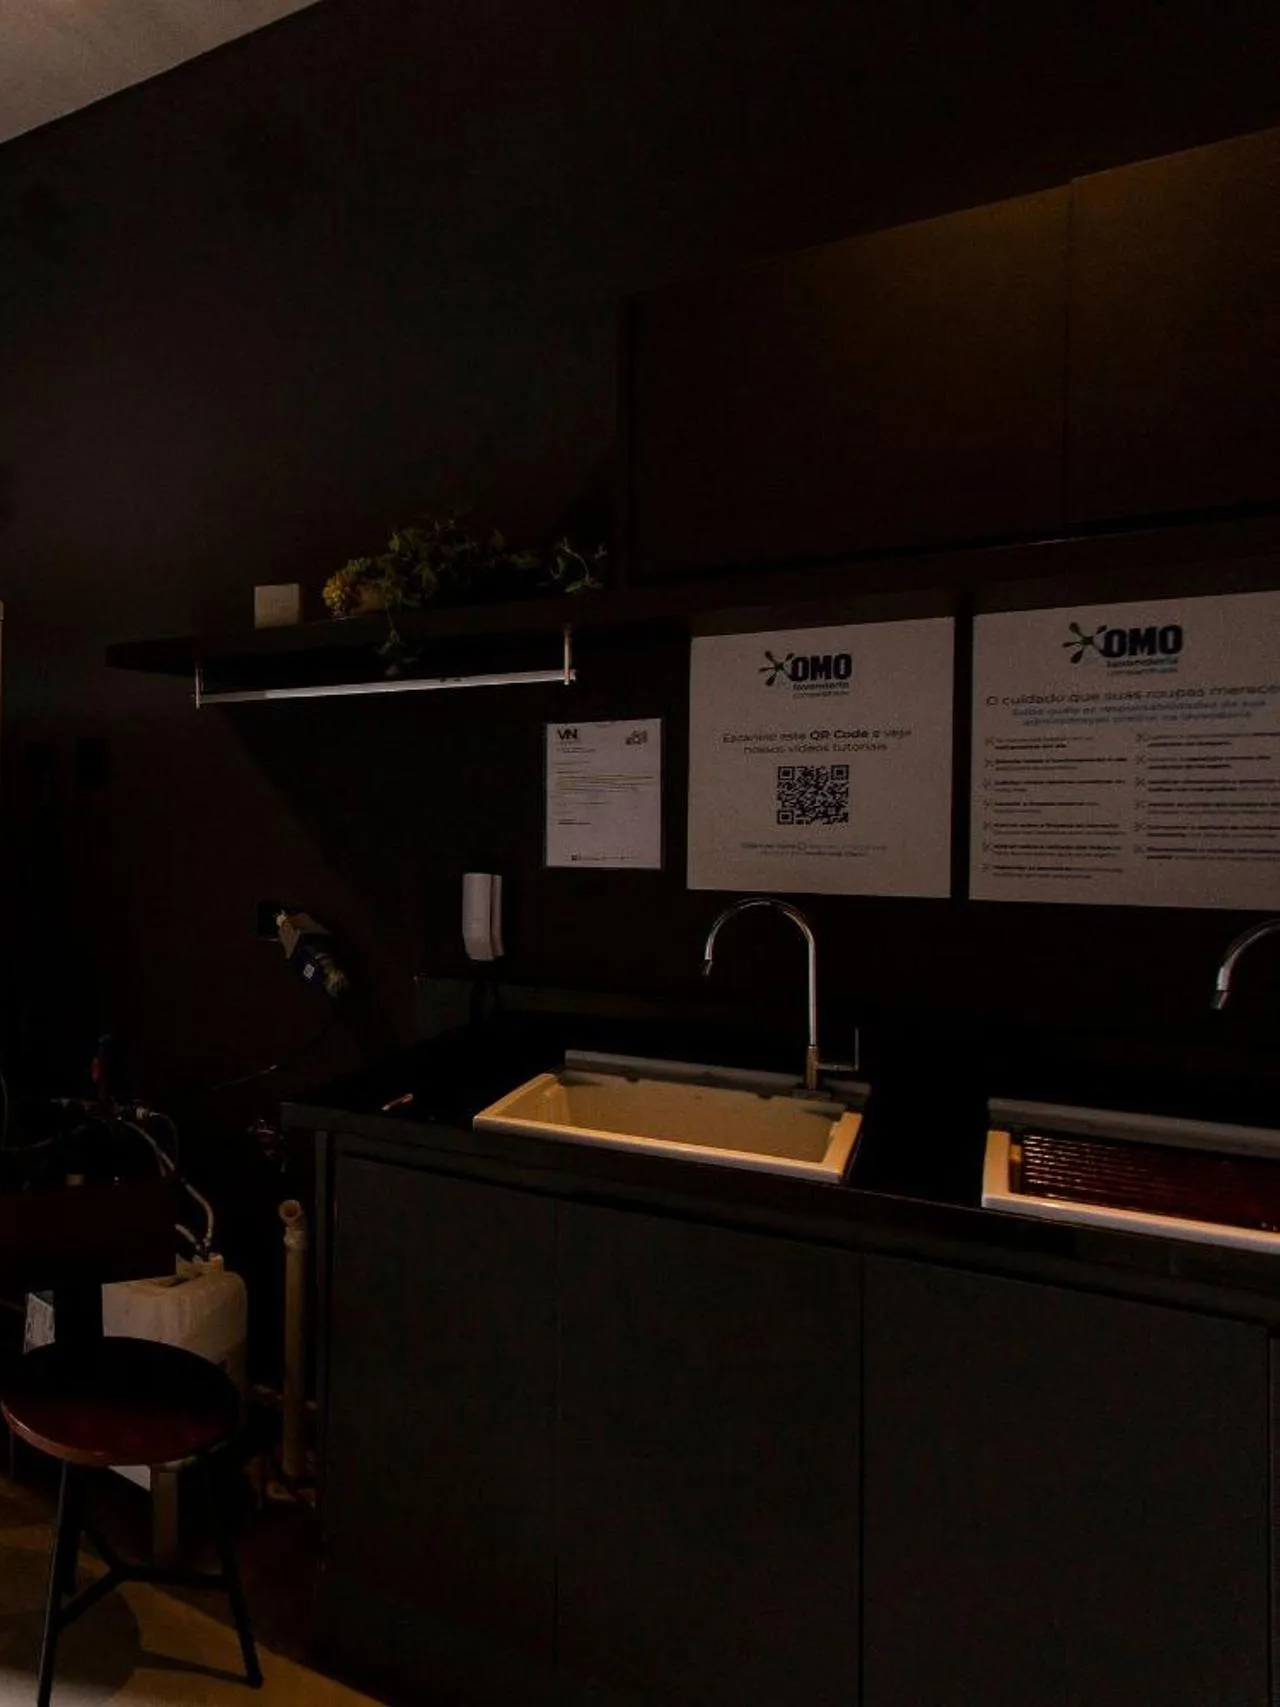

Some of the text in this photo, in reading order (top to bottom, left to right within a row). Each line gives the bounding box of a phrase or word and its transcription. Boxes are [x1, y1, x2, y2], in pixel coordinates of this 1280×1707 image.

[1104, 625, 1183, 658] OMO
[790, 653, 852, 682] OMO
[1002, 692, 1065, 706] cuidado
[1068, 691, 1100, 704] que
[1146, 687, 1206, 700] roupas
[810, 729, 831, 741] QR
[833, 728, 869, 740] Code
